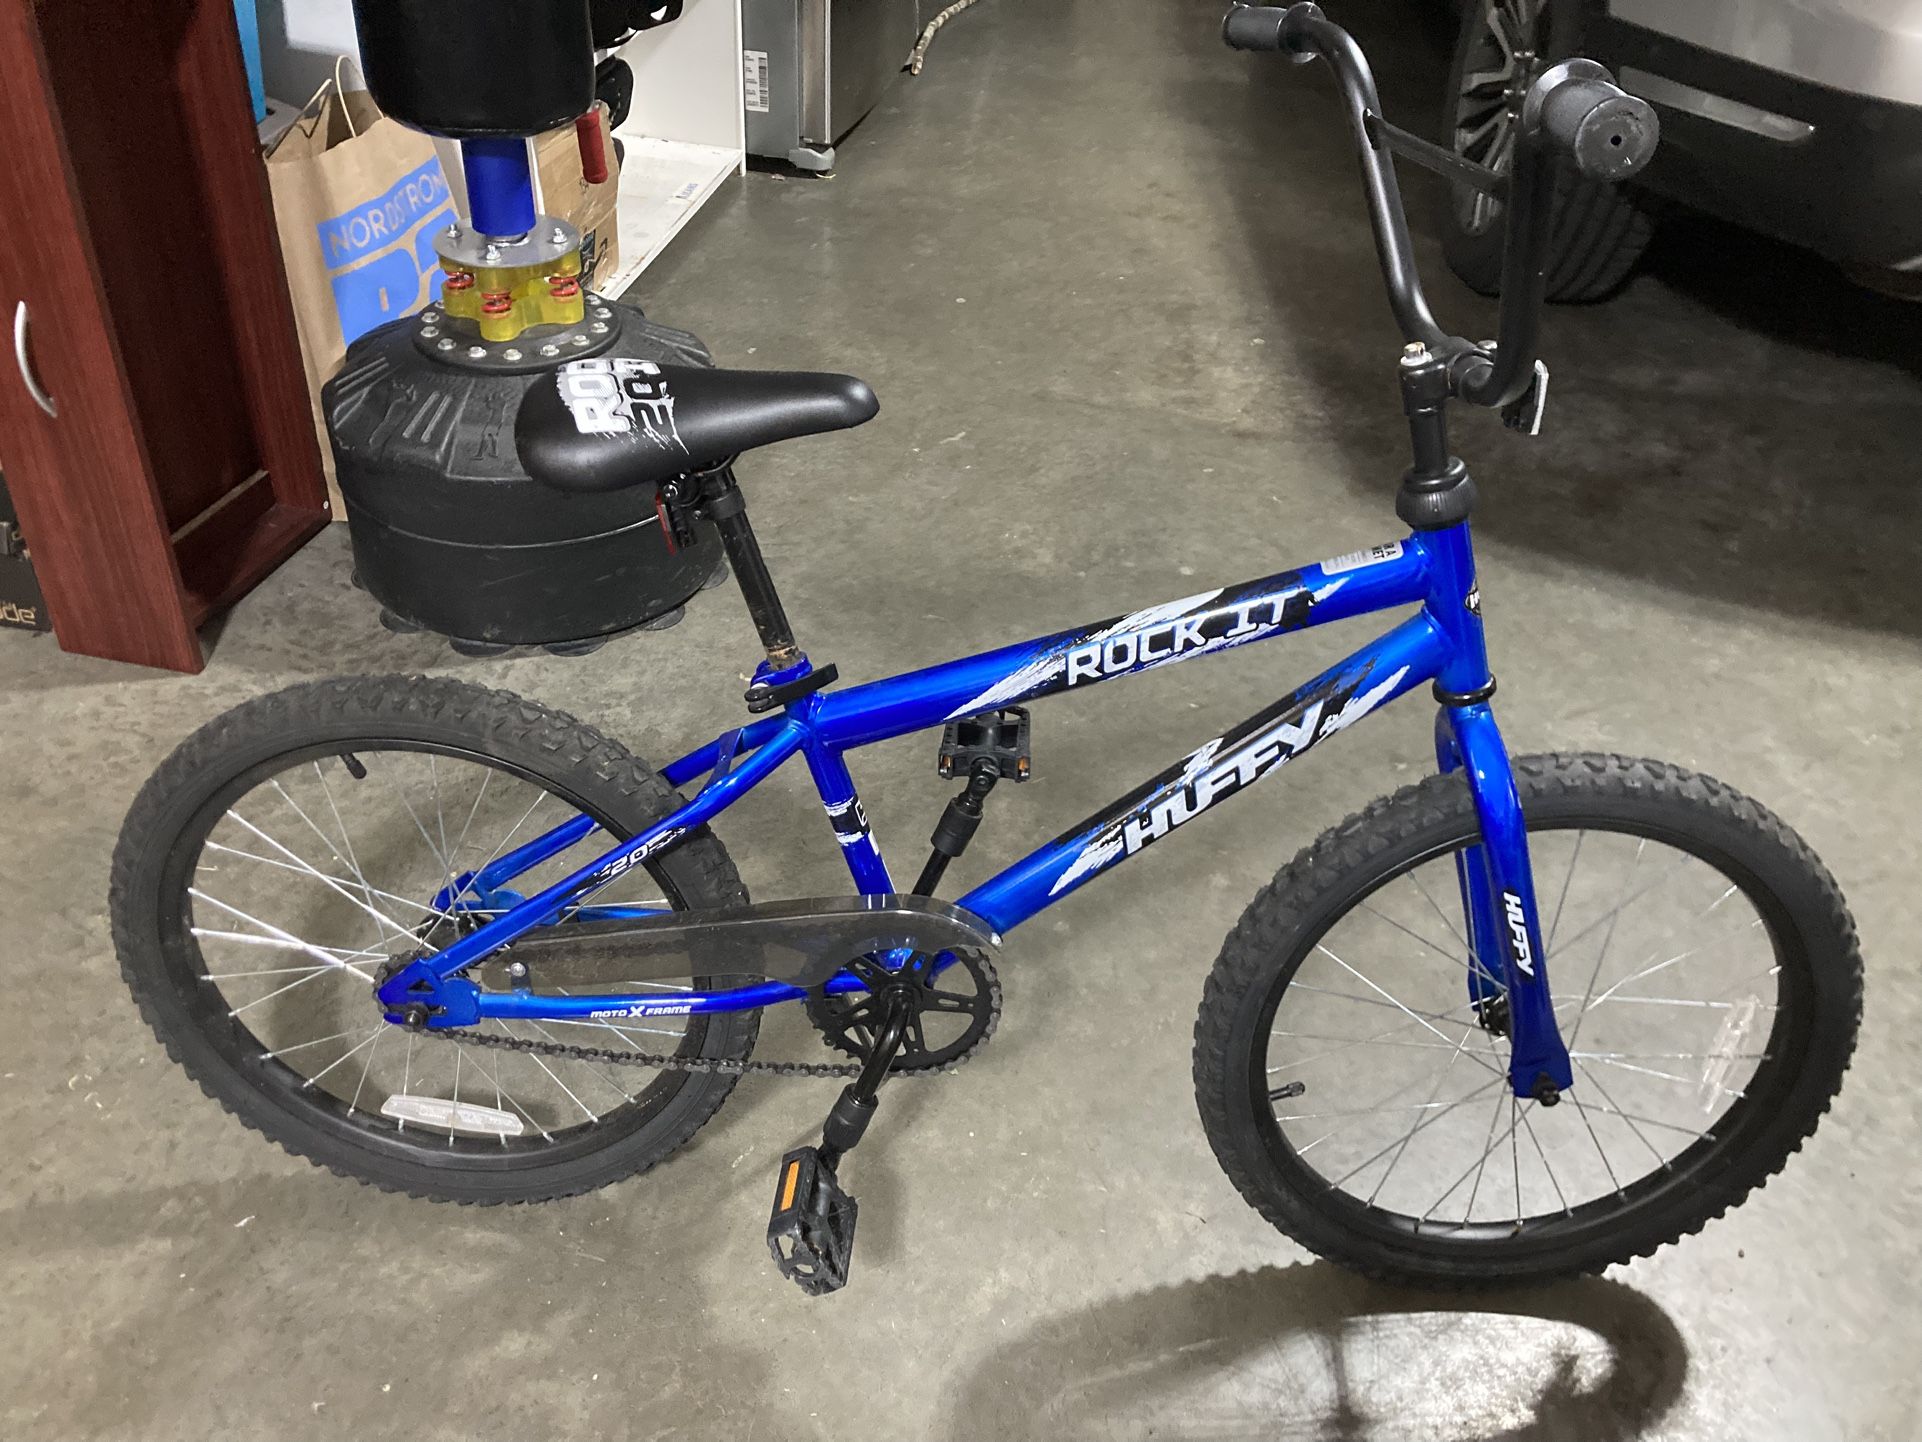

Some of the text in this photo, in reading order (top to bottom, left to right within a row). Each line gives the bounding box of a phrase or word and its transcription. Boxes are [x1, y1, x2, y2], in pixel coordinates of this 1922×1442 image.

[1067, 587, 1309, 686] ROCK IT
[1124, 700, 1325, 856] HUFFY
[1503, 891, 1535, 977] HUFFY
[590, 1005, 692, 1019] MOTO X FRAME
